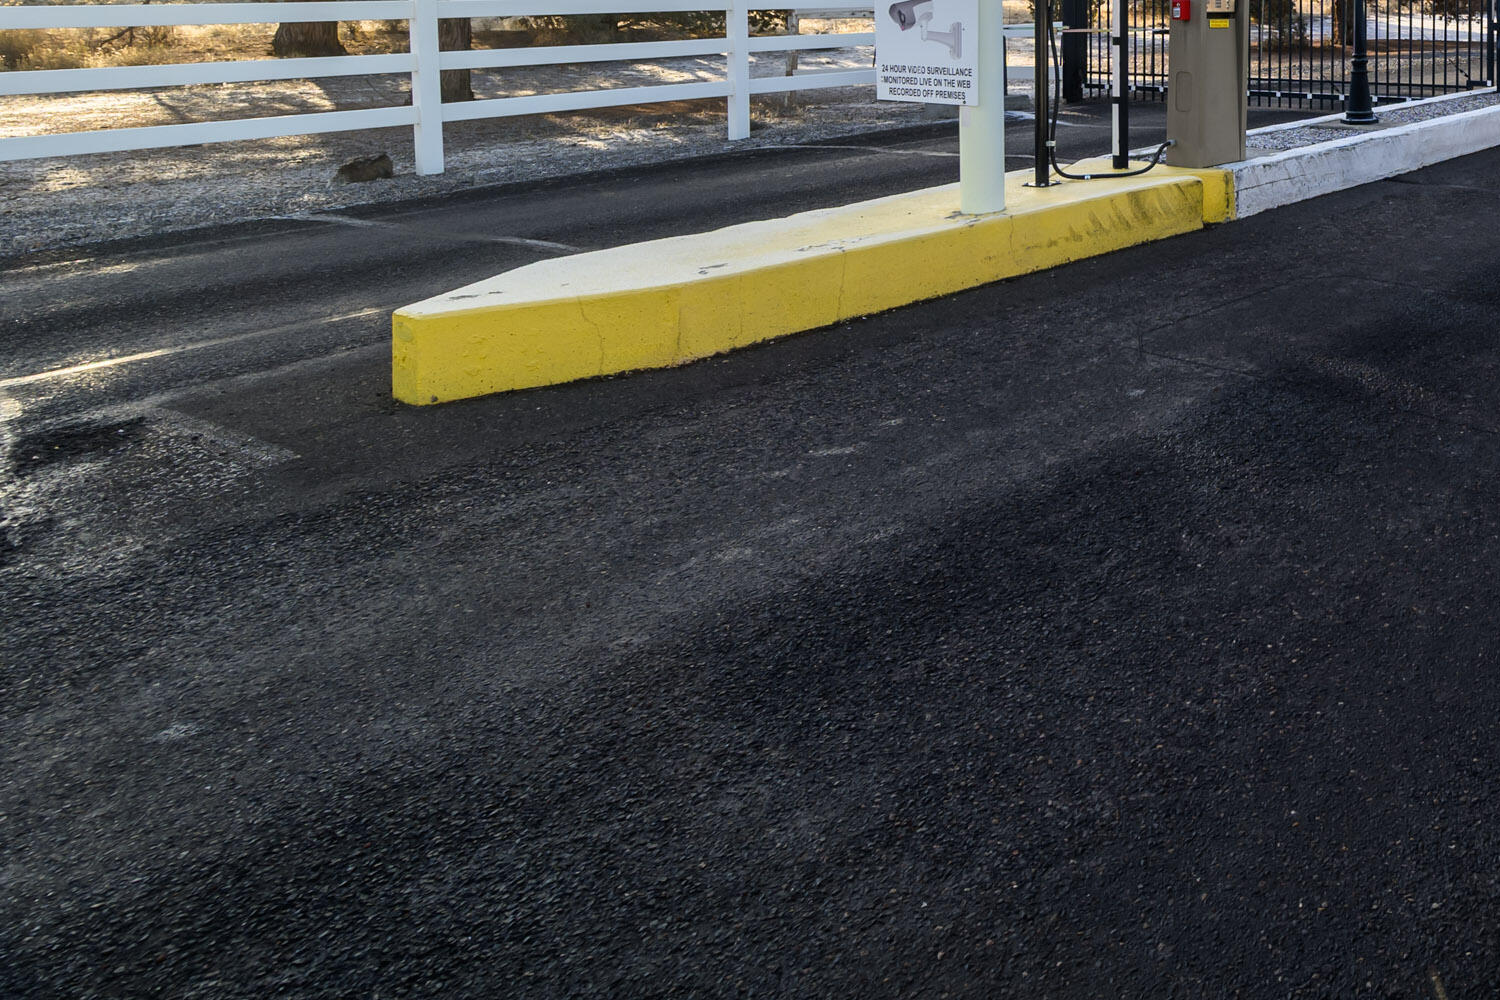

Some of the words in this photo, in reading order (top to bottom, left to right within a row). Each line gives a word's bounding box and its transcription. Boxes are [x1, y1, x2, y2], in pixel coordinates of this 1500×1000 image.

[882, 64, 889, 73] 24
[889, 64, 907, 73] HOUR
[907, 65, 926, 75] VIDEO
[926, 66, 973, 77] SURVEILLANCE
[883, 75, 918, 86] MONITORED
[919, 77, 932, 87] LIVE
[933, 78, 943, 87] ON
[944, 79, 956, 88] THE
[957, 79, 971, 89] WEB
[889, 87, 921, 98] RECORDED
[922, 89, 934, 98] OFF
[935, 90, 966, 100] PREMISES
